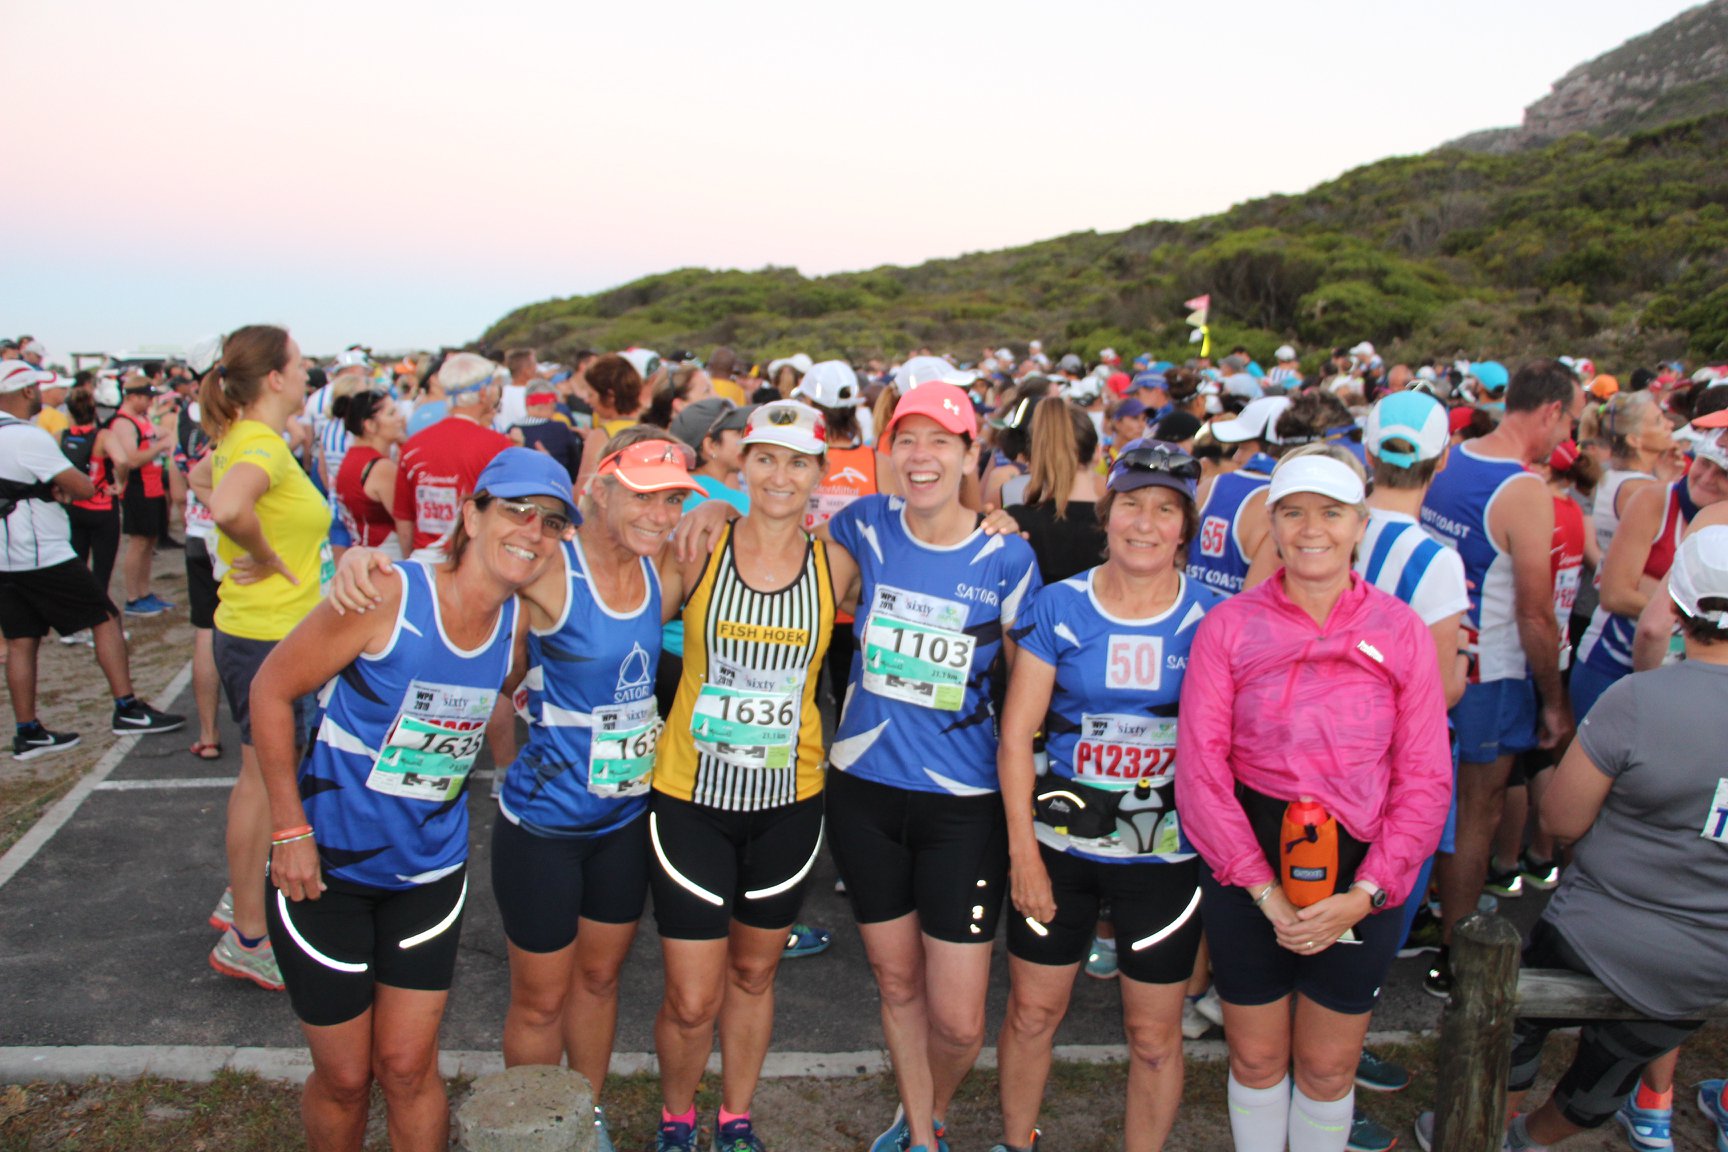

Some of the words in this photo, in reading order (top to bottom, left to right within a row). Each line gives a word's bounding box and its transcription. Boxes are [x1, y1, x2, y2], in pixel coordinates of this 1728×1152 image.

[1436, 514, 1471, 538] COAST
[1205, 569, 1246, 591] COAST
[880, 591, 897, 602] WPA
[905, 599, 934, 616] sixty
[720, 623, 758, 639] FISH
[762, 630, 805, 643] HOEK
[892, 628, 970, 668] 1103
[1110, 642, 1156, 686] 50
[719, 666, 736, 678] WPA
[745, 677, 776, 692] sixty
[415, 691, 434, 701] WPA
[443, 693, 469, 708] sixty
[718, 695, 794, 726] 1636
[602, 713, 618, 722] WPA
[1117, 722, 1148, 737] sixty
[419, 732, 485, 760] 1635
[1076, 741, 1177, 779] P12327
